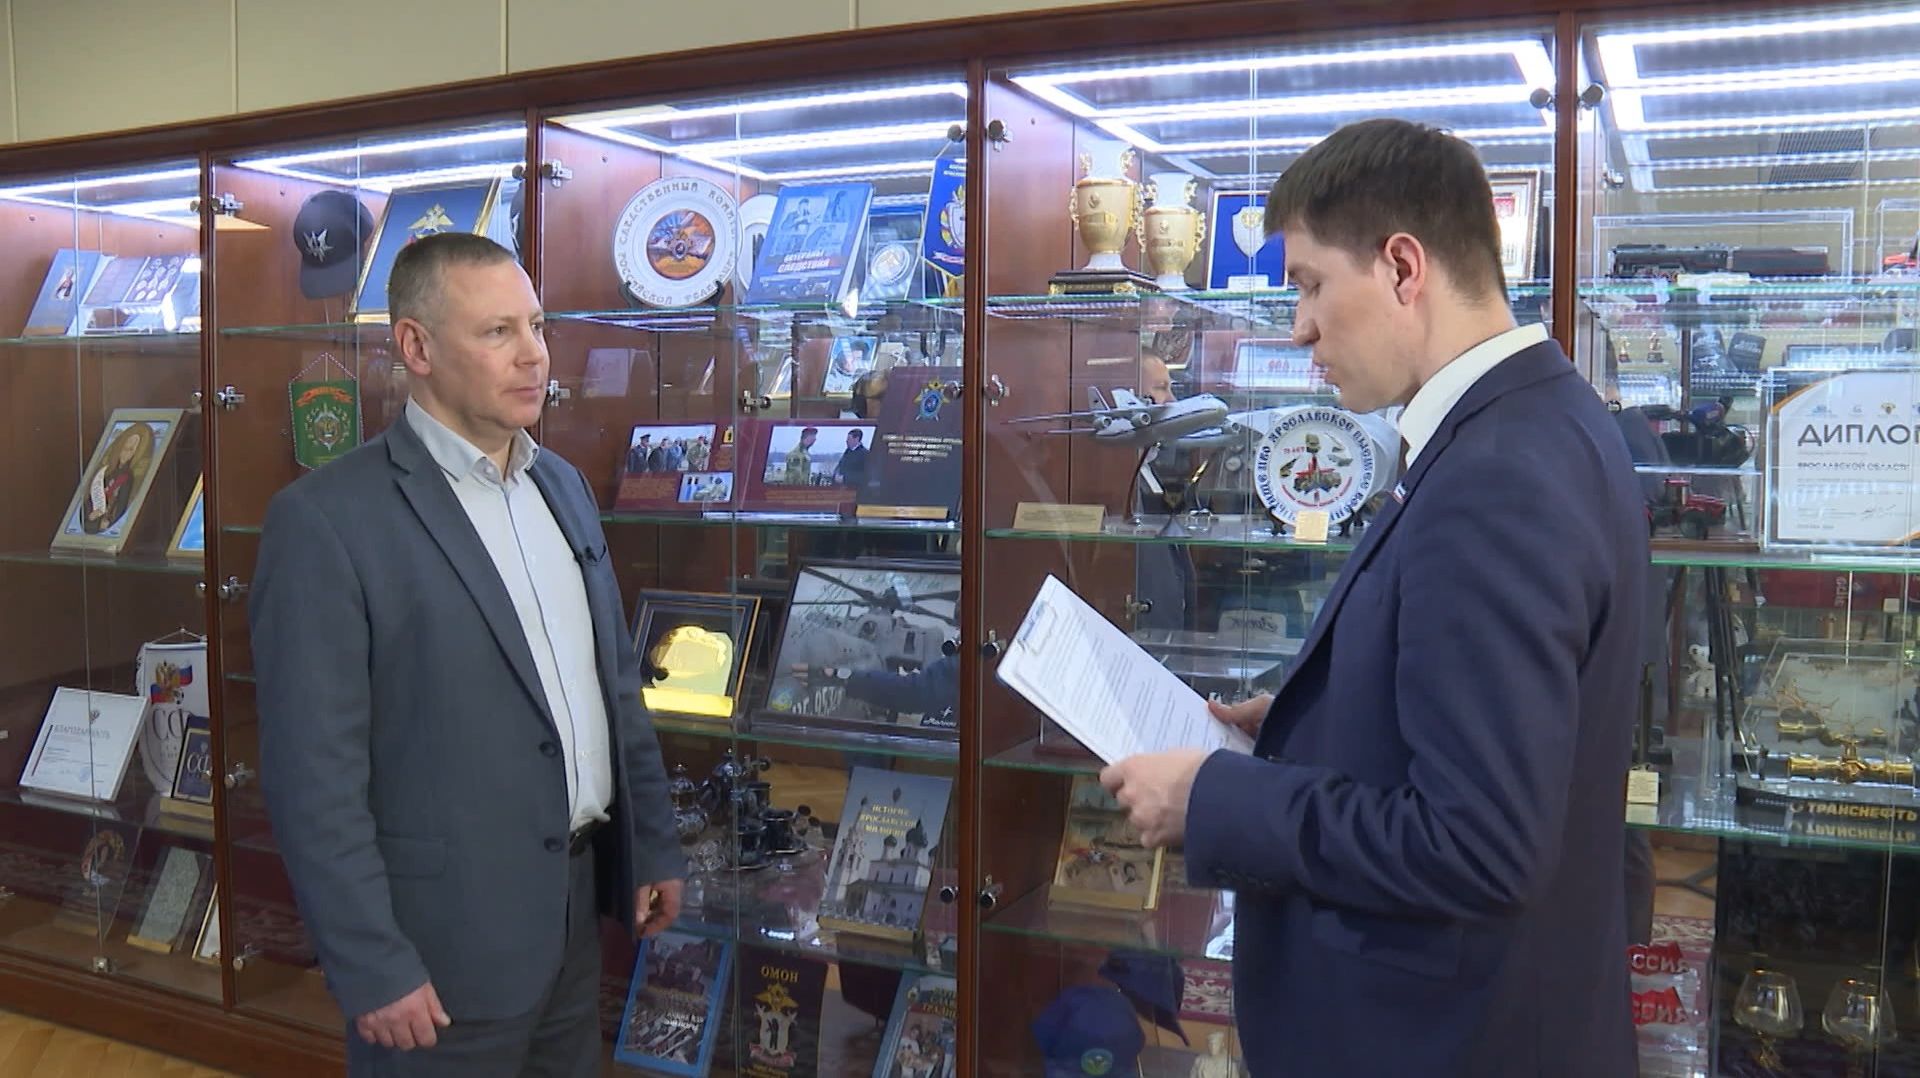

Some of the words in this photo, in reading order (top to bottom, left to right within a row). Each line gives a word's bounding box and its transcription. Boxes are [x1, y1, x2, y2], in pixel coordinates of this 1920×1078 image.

[1807, 801, 1918, 822] ТРАНСНЕФТЬ
[760, 965, 800, 983] ОМОН
[1631, 953, 1691, 975] ССИЯ
